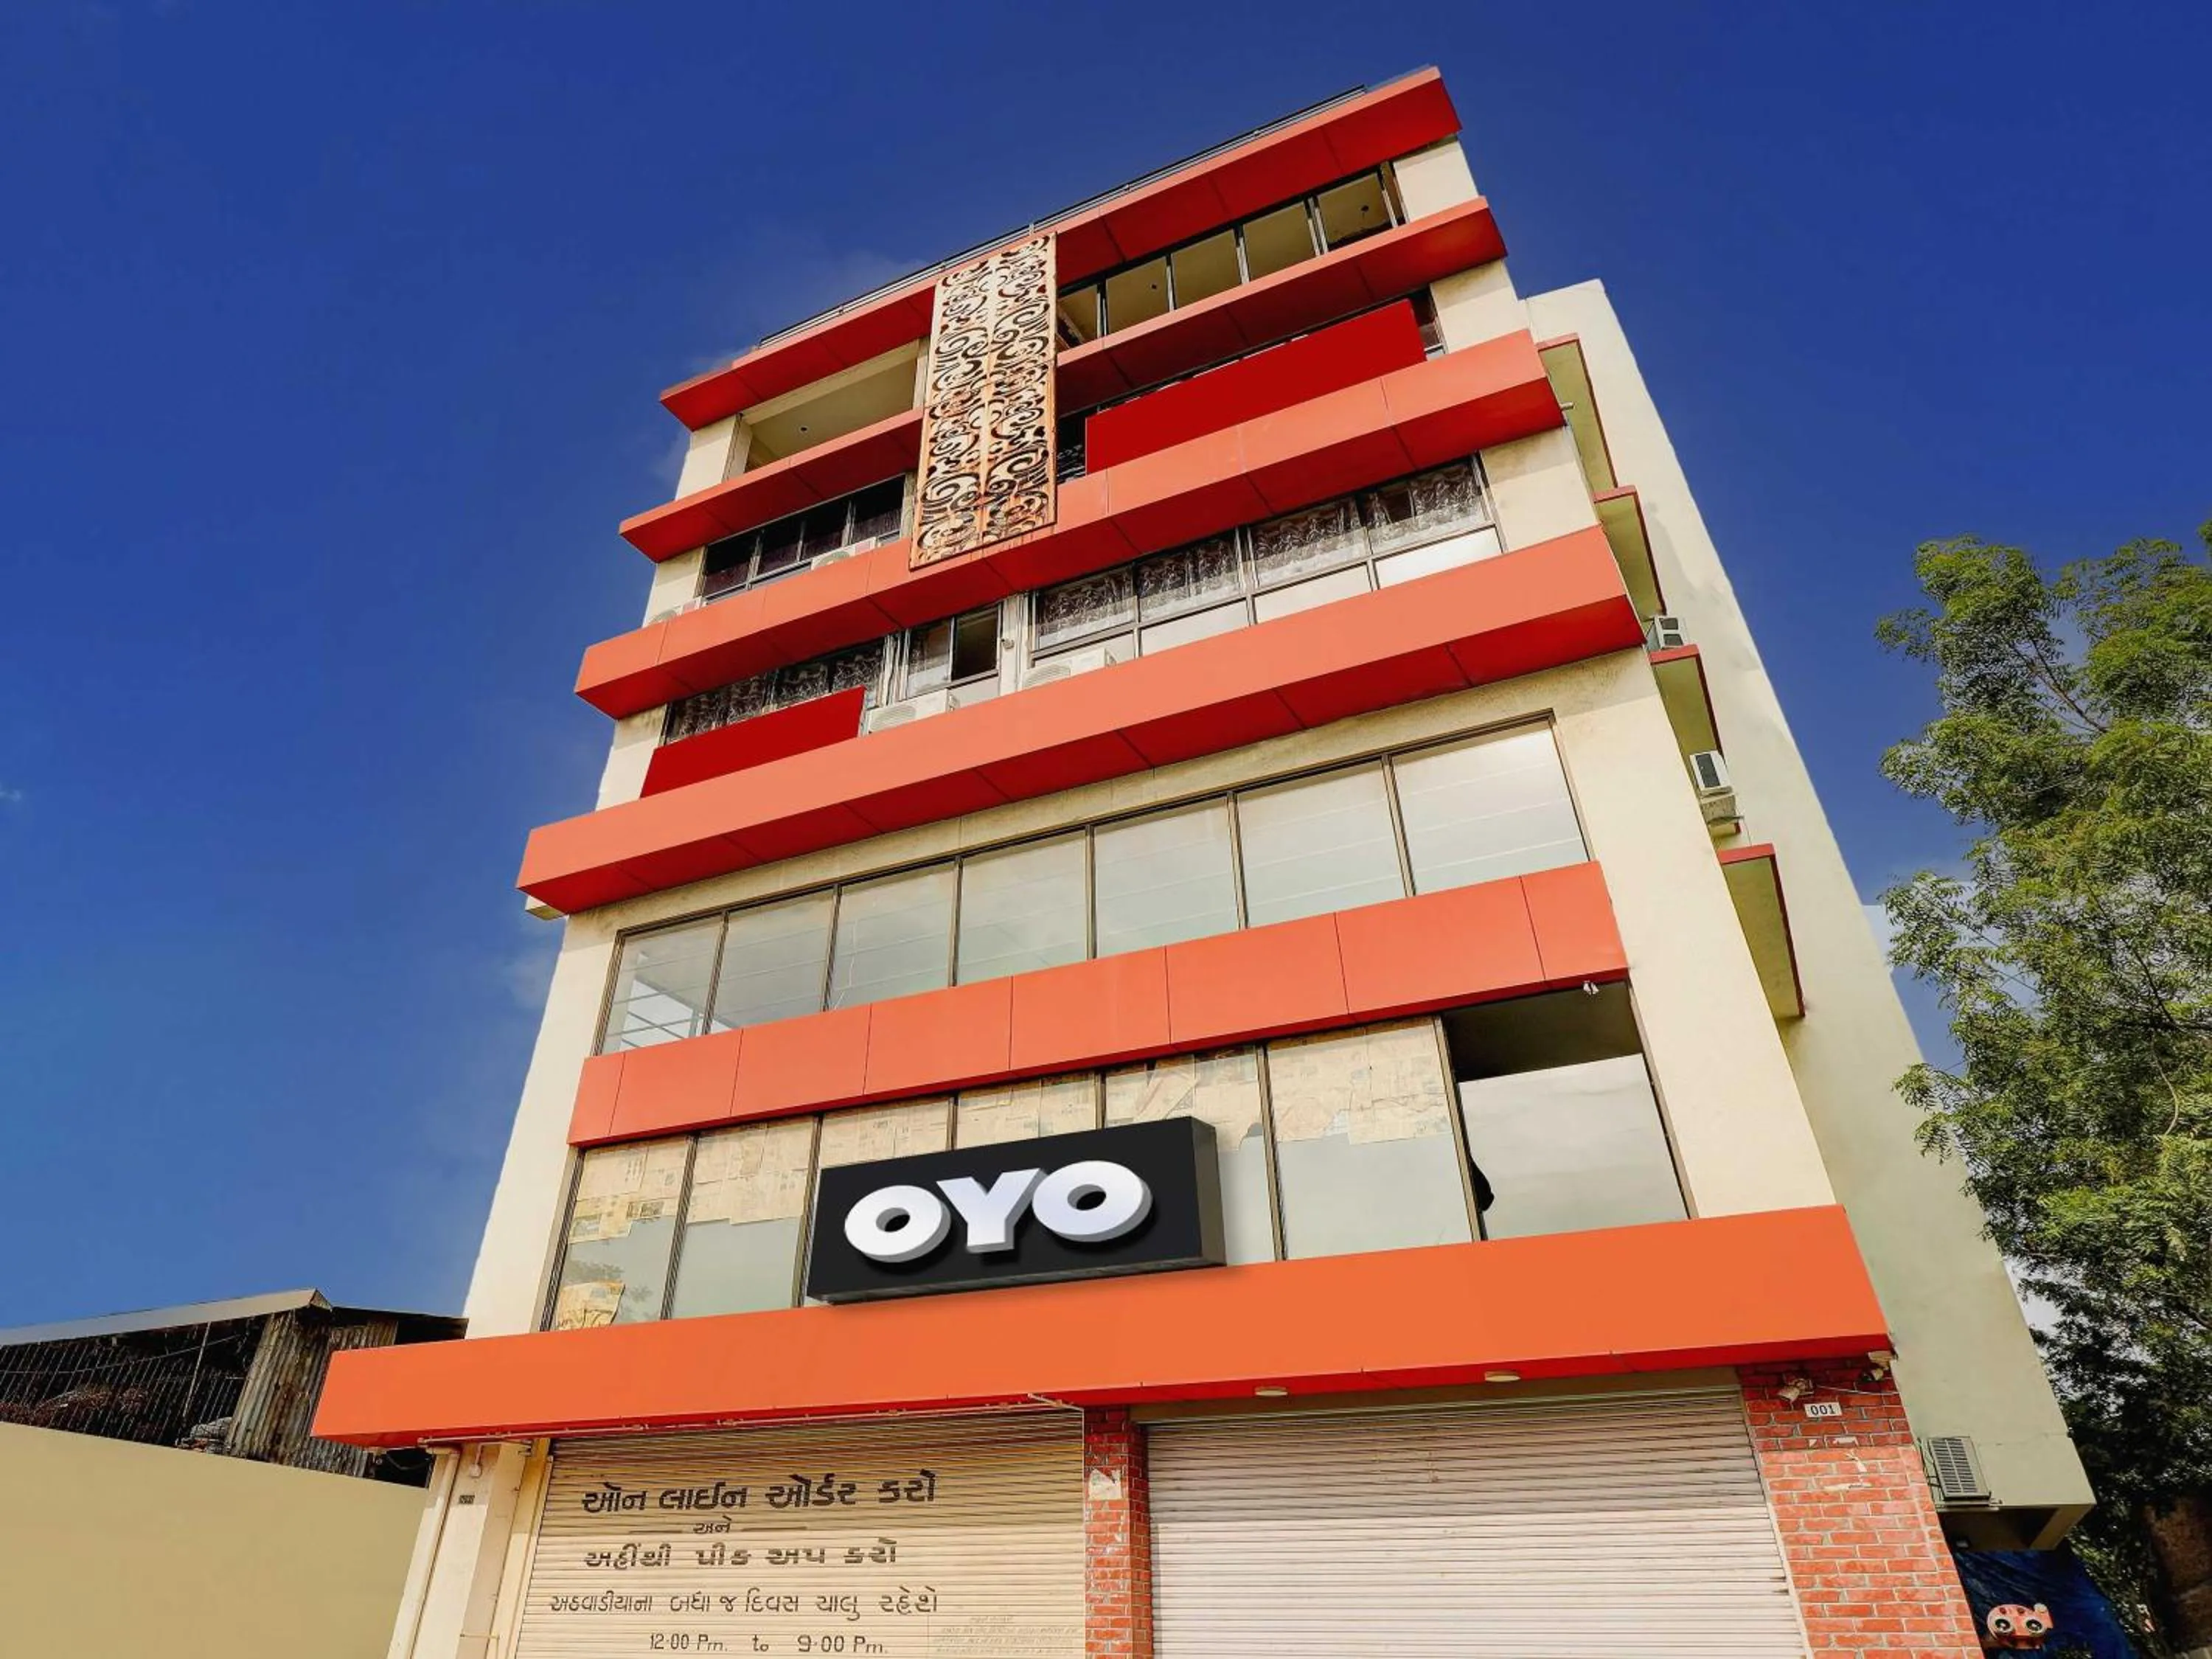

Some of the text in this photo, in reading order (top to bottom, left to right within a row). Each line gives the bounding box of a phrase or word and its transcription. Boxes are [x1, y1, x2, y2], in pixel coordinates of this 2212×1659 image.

[844, 1160, 1152, 1263] OYO
[1810, 1405, 1836, 1415] 001
[877, 1468, 936, 1503] કરો
[693, 1514, 732, 1534] અને
[765, 1548, 825, 1565] અપ
[844, 1537, 897, 1564] કરો
[720, 1596, 738, 1613] જ
[745, 1587, 799, 1613] દિવસ
[752, 1635, 769, 1652] to
